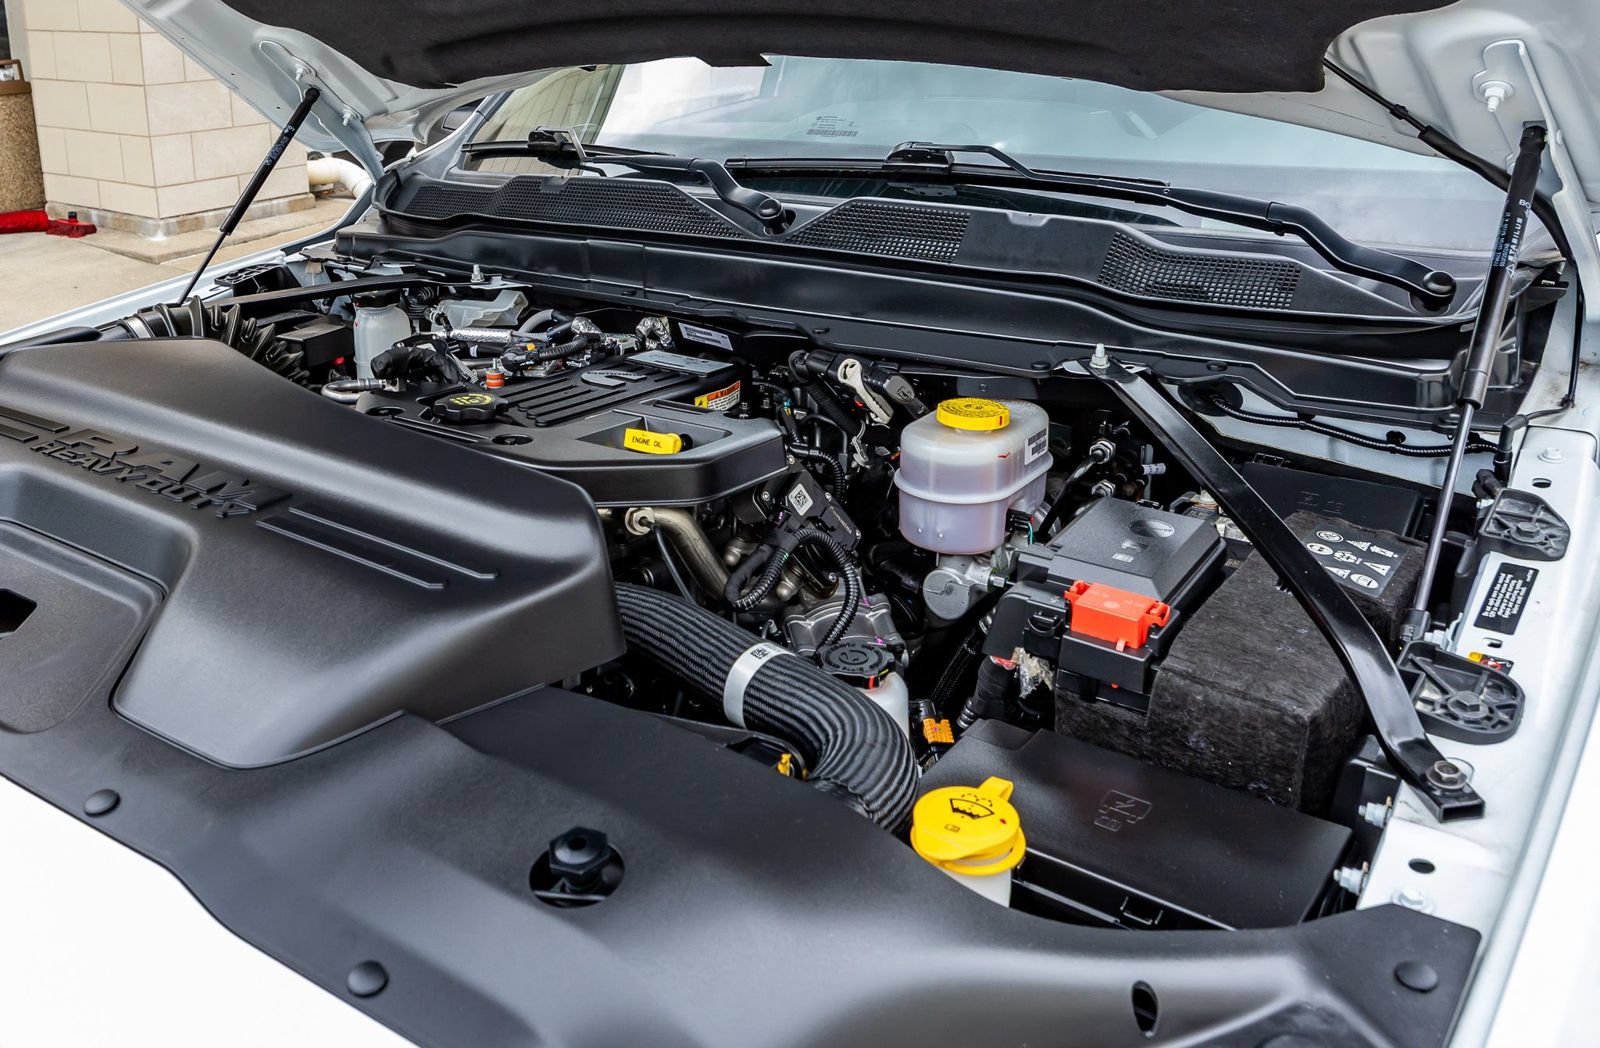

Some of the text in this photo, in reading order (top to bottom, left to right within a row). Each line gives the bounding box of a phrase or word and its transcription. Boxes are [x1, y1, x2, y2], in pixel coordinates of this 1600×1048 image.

[1508, 217, 1523, 261] STABILUS
[54, 428, 292, 511] RAM
[631, 436, 663, 449] ENGINE OIL
[30, 443, 250, 519] HEAVY DUTY
